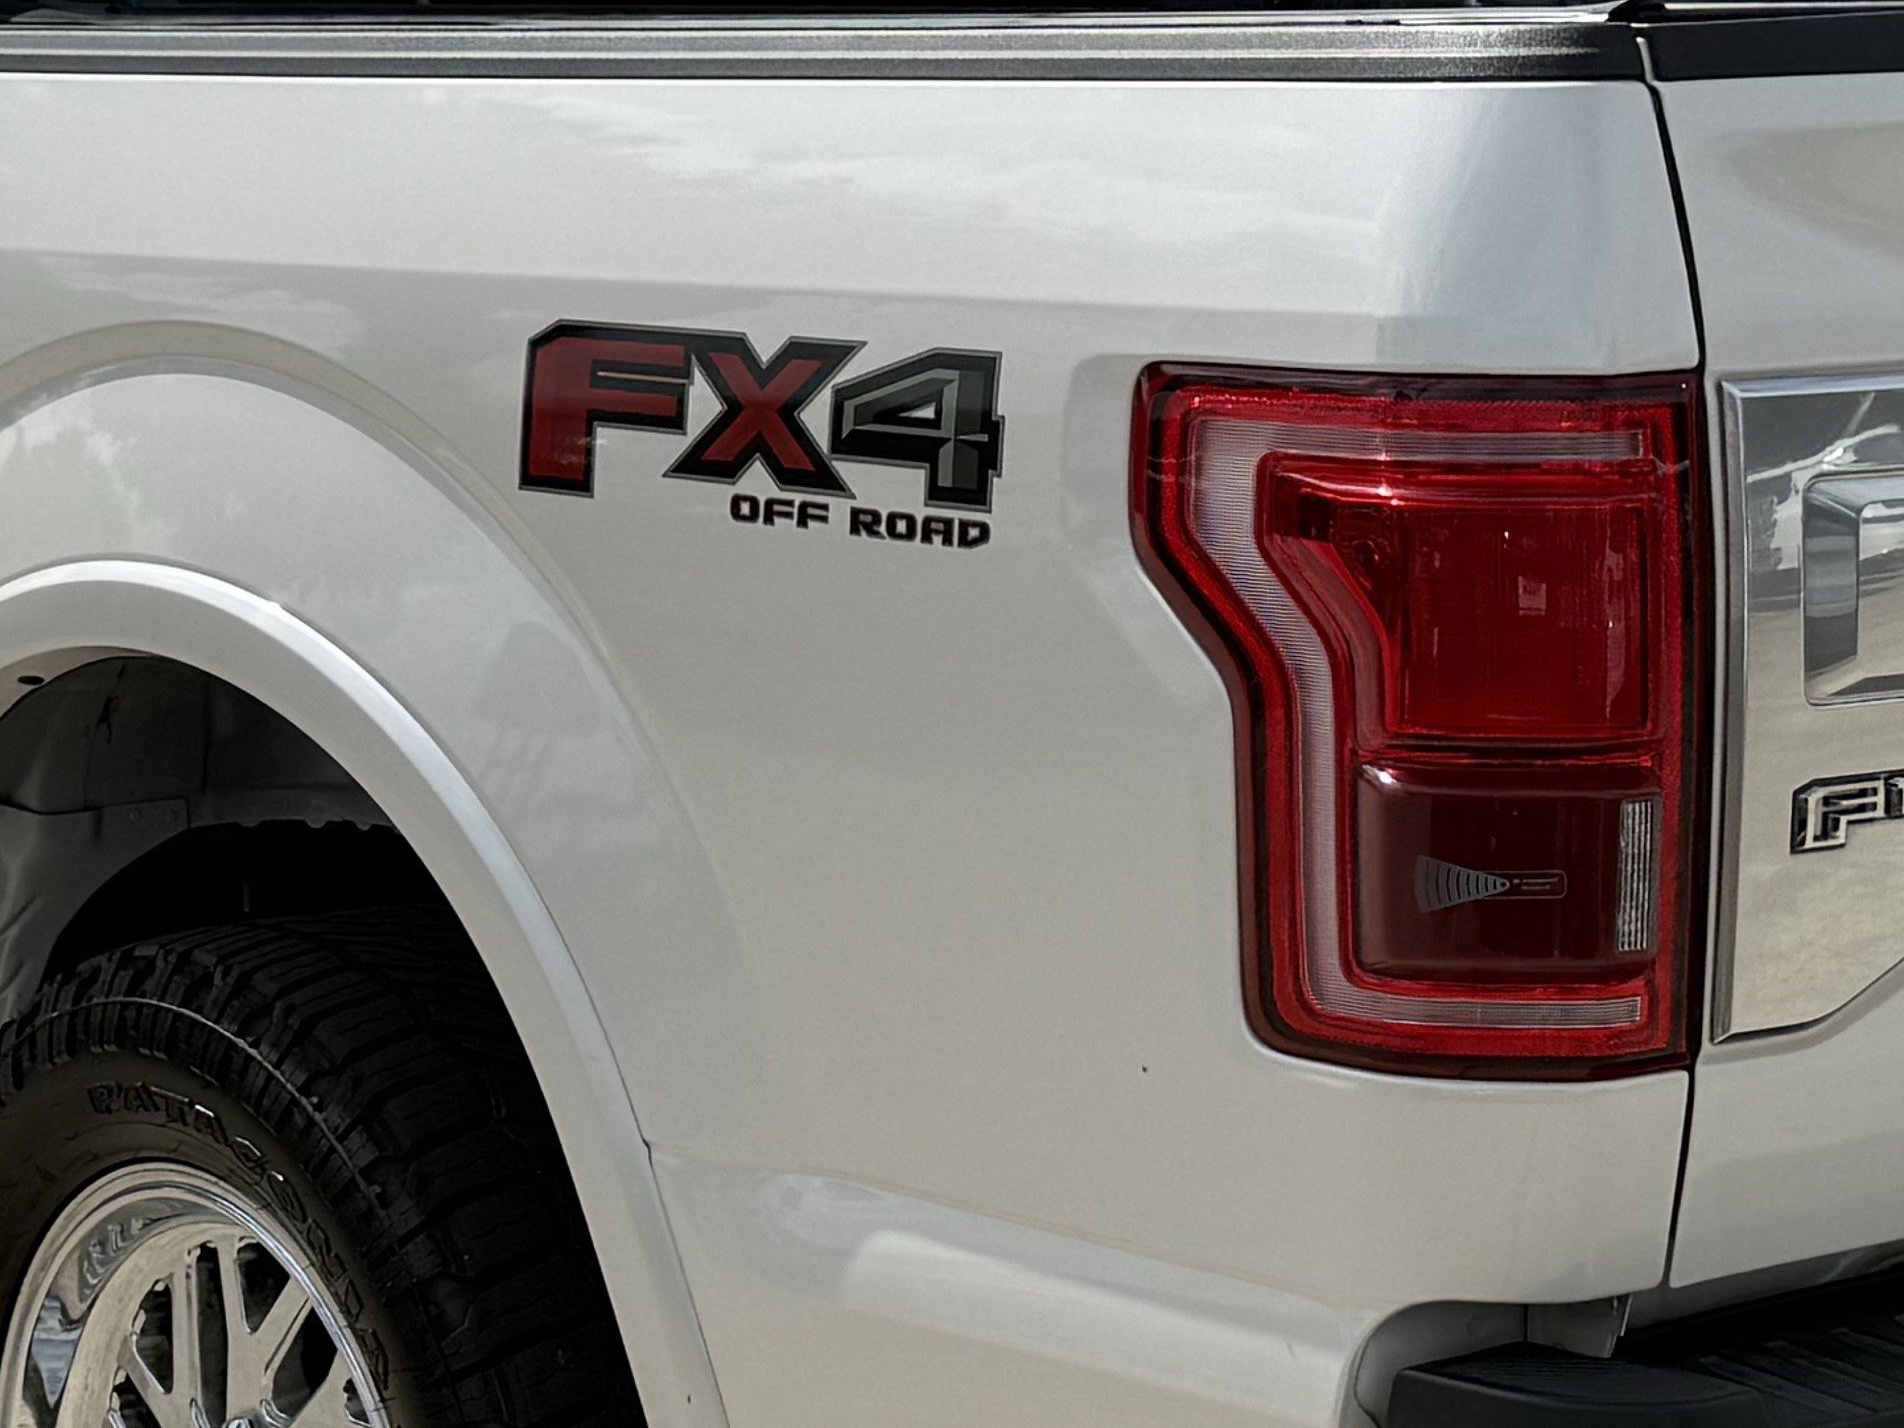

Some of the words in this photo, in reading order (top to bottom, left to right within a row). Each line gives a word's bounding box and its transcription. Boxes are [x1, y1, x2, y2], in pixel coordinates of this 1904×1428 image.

[518, 319, 1006, 513] FX4
[730, 493, 830, 529] OFF
[849, 505, 992, 550] ROAD
